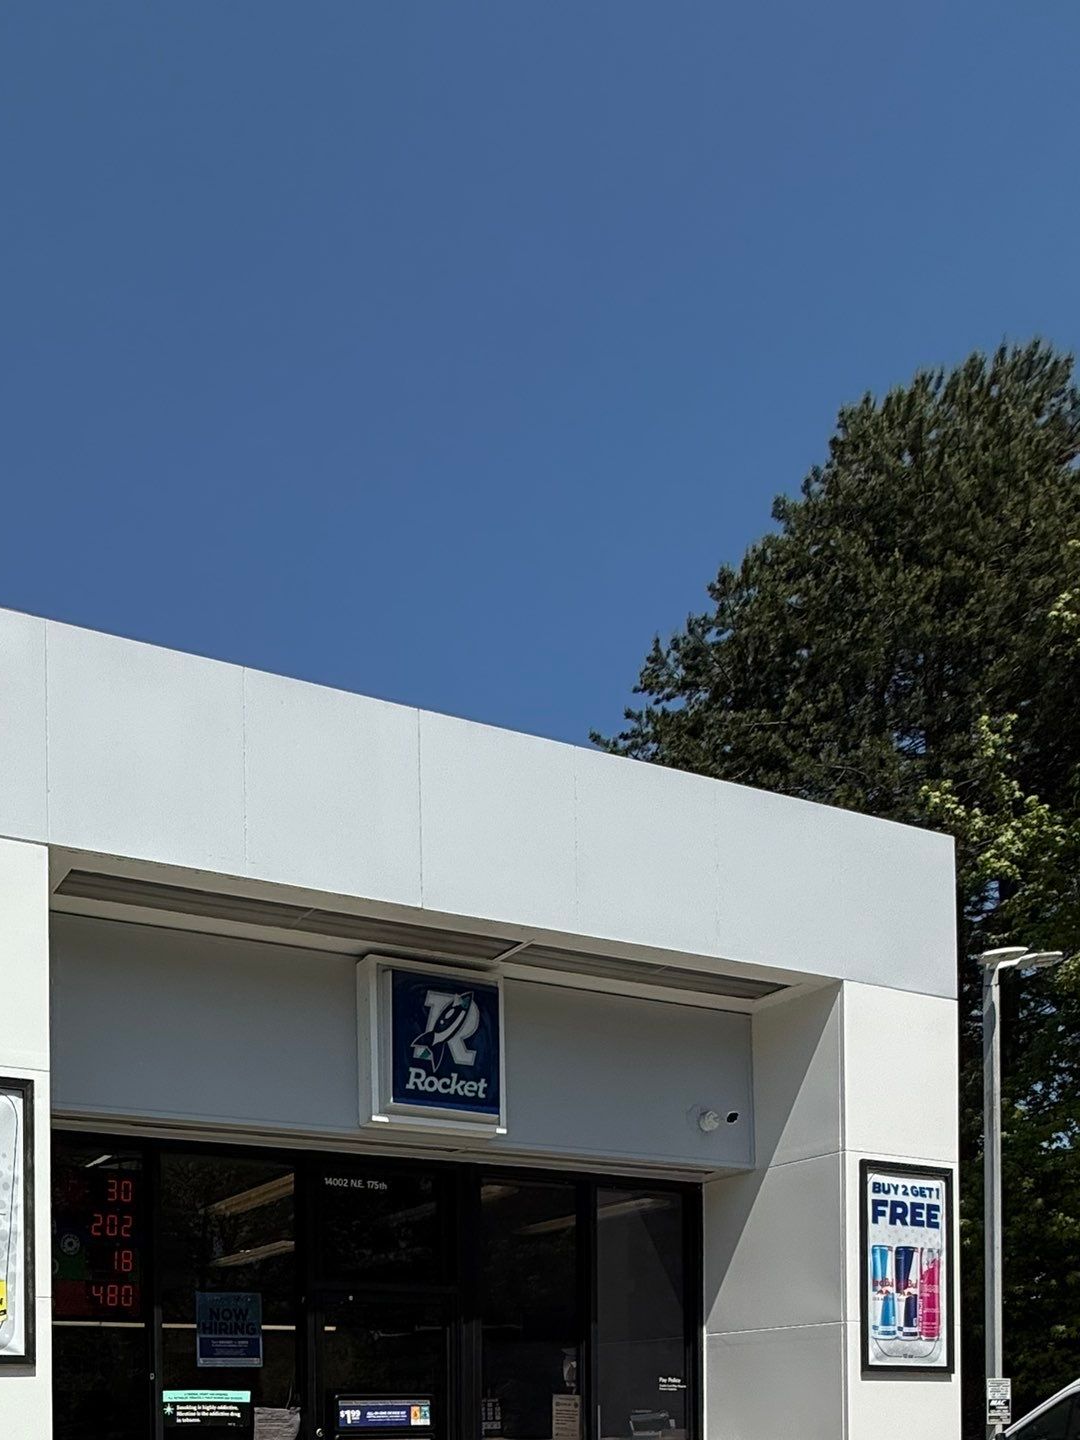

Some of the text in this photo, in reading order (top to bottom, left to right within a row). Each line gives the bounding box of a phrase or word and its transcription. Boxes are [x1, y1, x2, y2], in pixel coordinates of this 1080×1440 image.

[405, 1067, 487, 1098] Rocket
[107, 1180, 132, 1202] 30
[324, 1177, 349, 1187] 14002
[367, 1181, 387, 1190] 175th
[872, 1182, 939, 1199] BUY 2 GET 1
[872, 1199, 940, 1229] FREE
[91, 1214, 132, 1237] 202
[114, 1250, 132, 1271] 18
[92, 1285, 132, 1306] 480
[209, 1308, 248, 1321] NOW
[202, 1322, 256, 1335] HIRING
